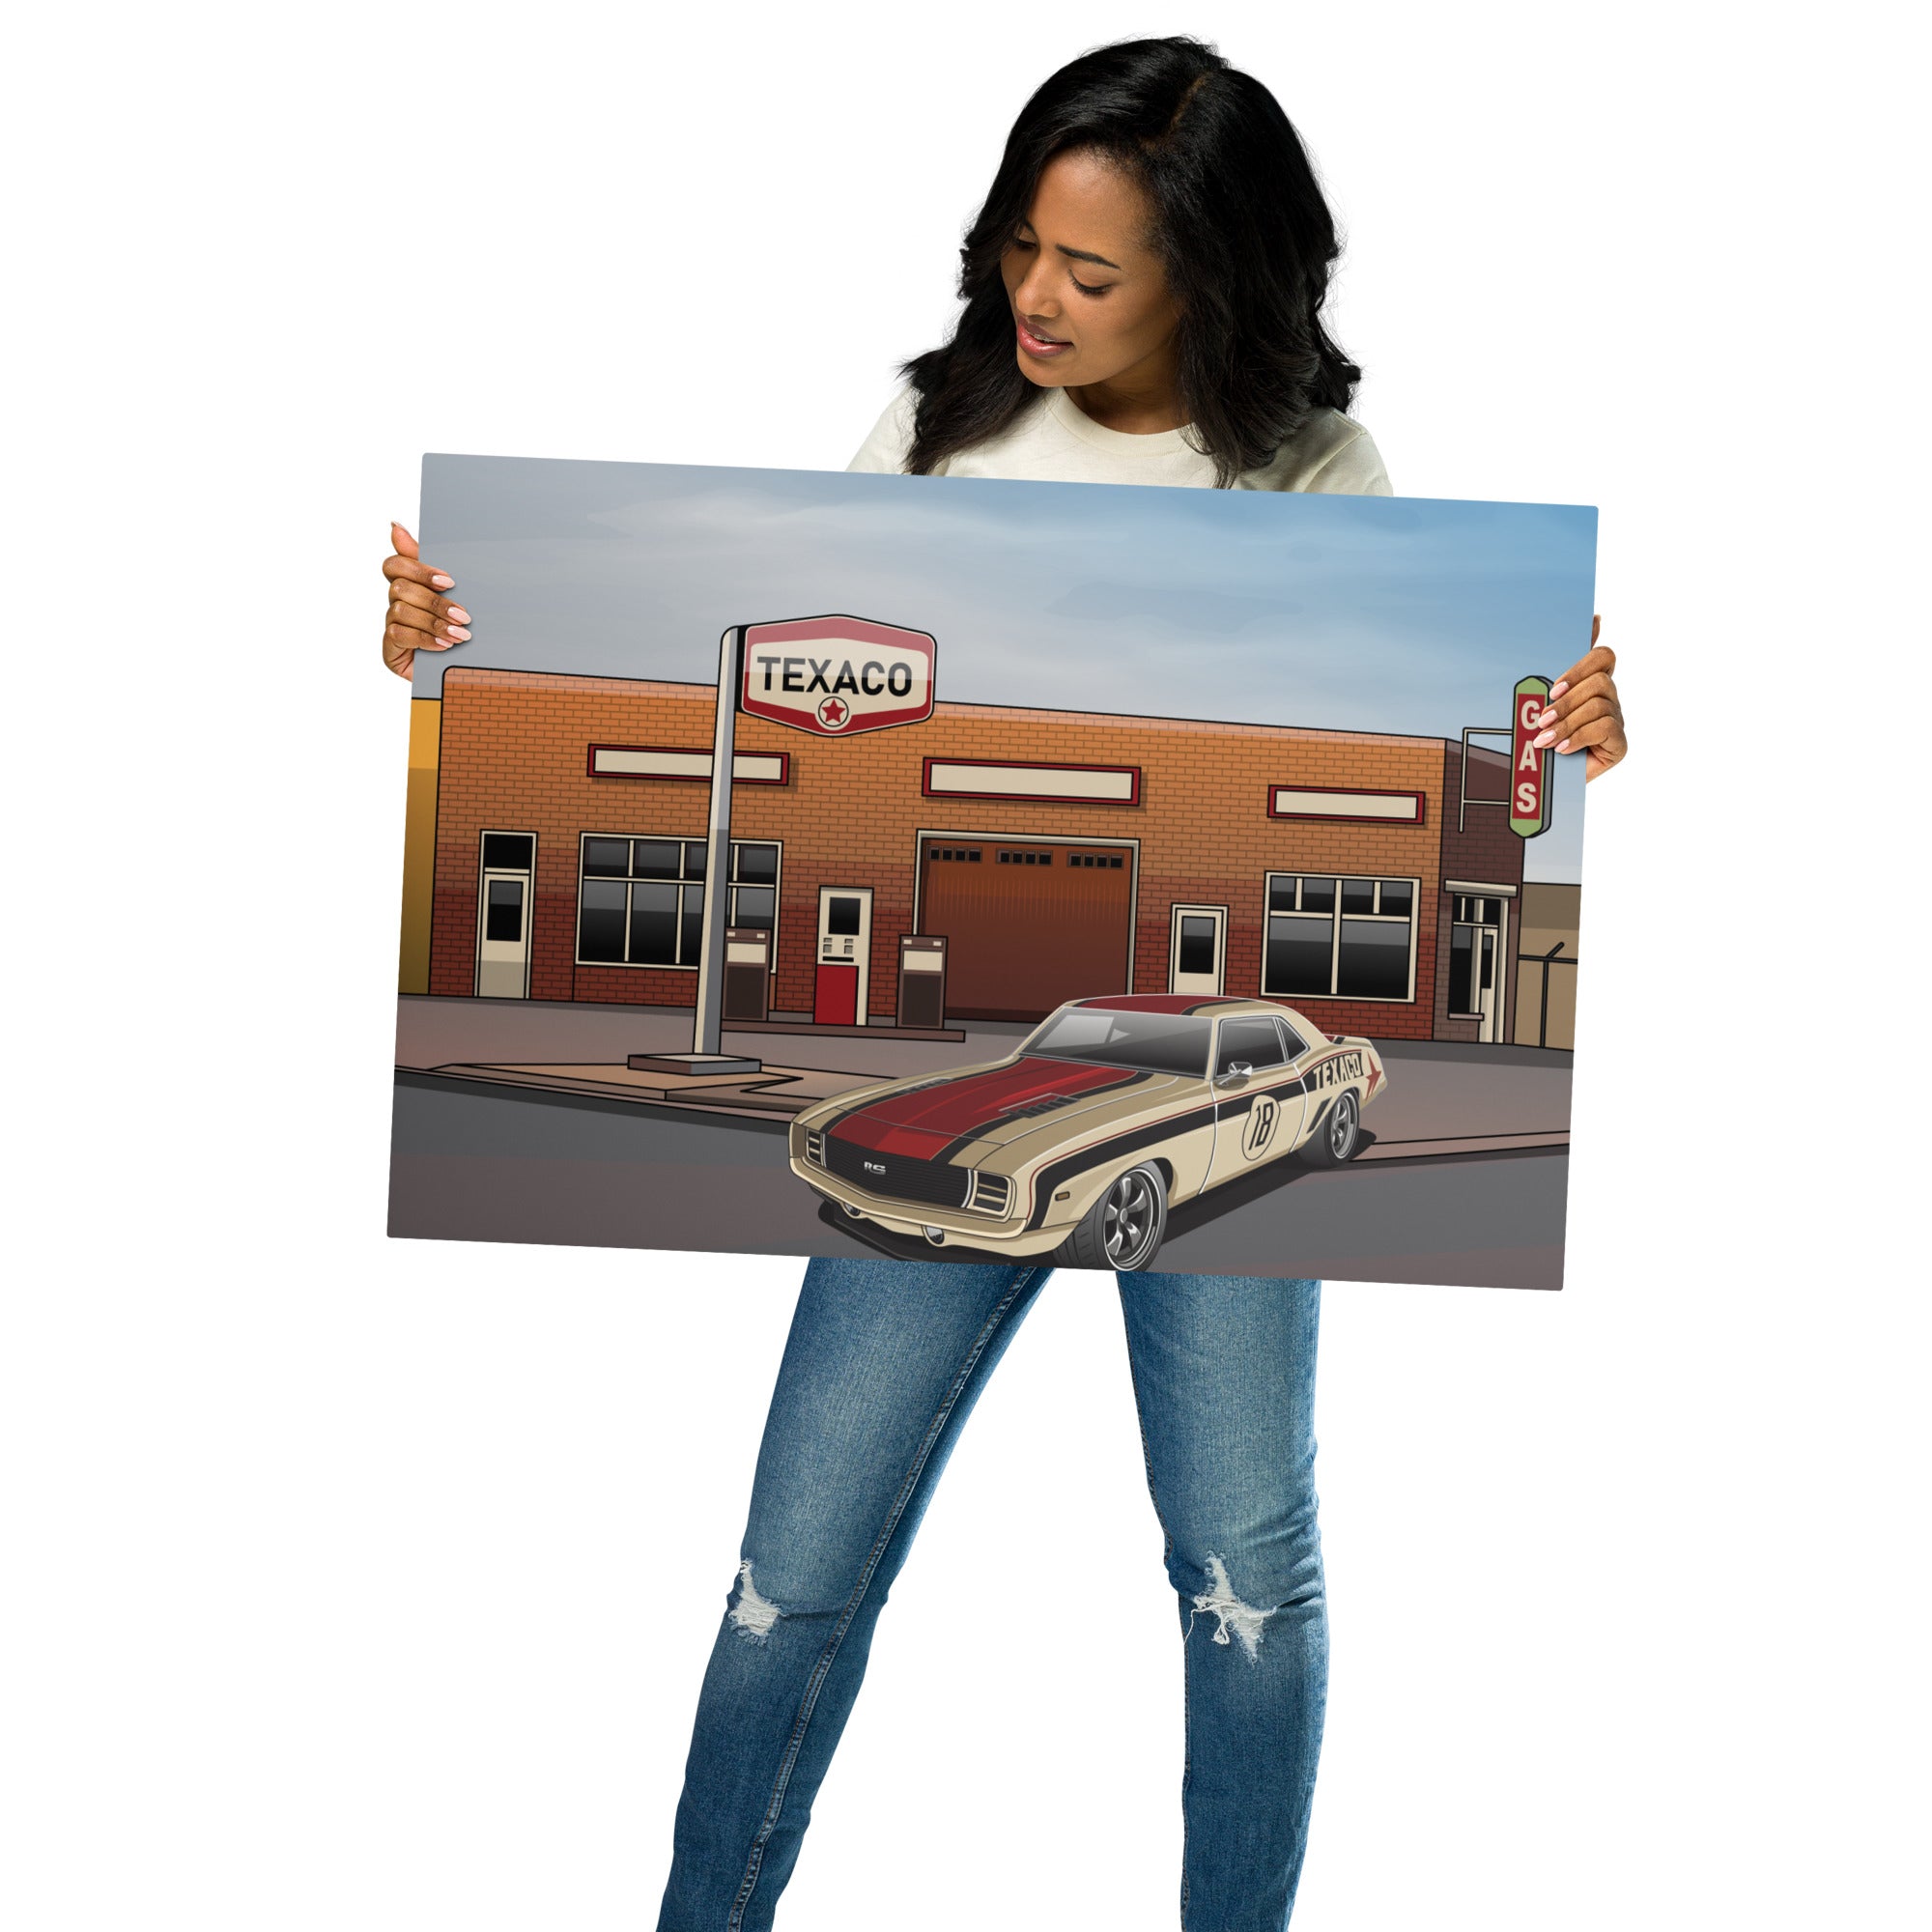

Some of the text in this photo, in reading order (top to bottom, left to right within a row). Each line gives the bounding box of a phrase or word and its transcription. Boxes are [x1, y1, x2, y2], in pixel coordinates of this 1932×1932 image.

[756, 656, 913, 697] TEXACO
[1516, 699, 1541, 813] GAS
[1313, 1053, 1364, 1091] TEXACO
[1248, 1101, 1274, 1151] 18
[864, 1161, 887, 1176] RS
